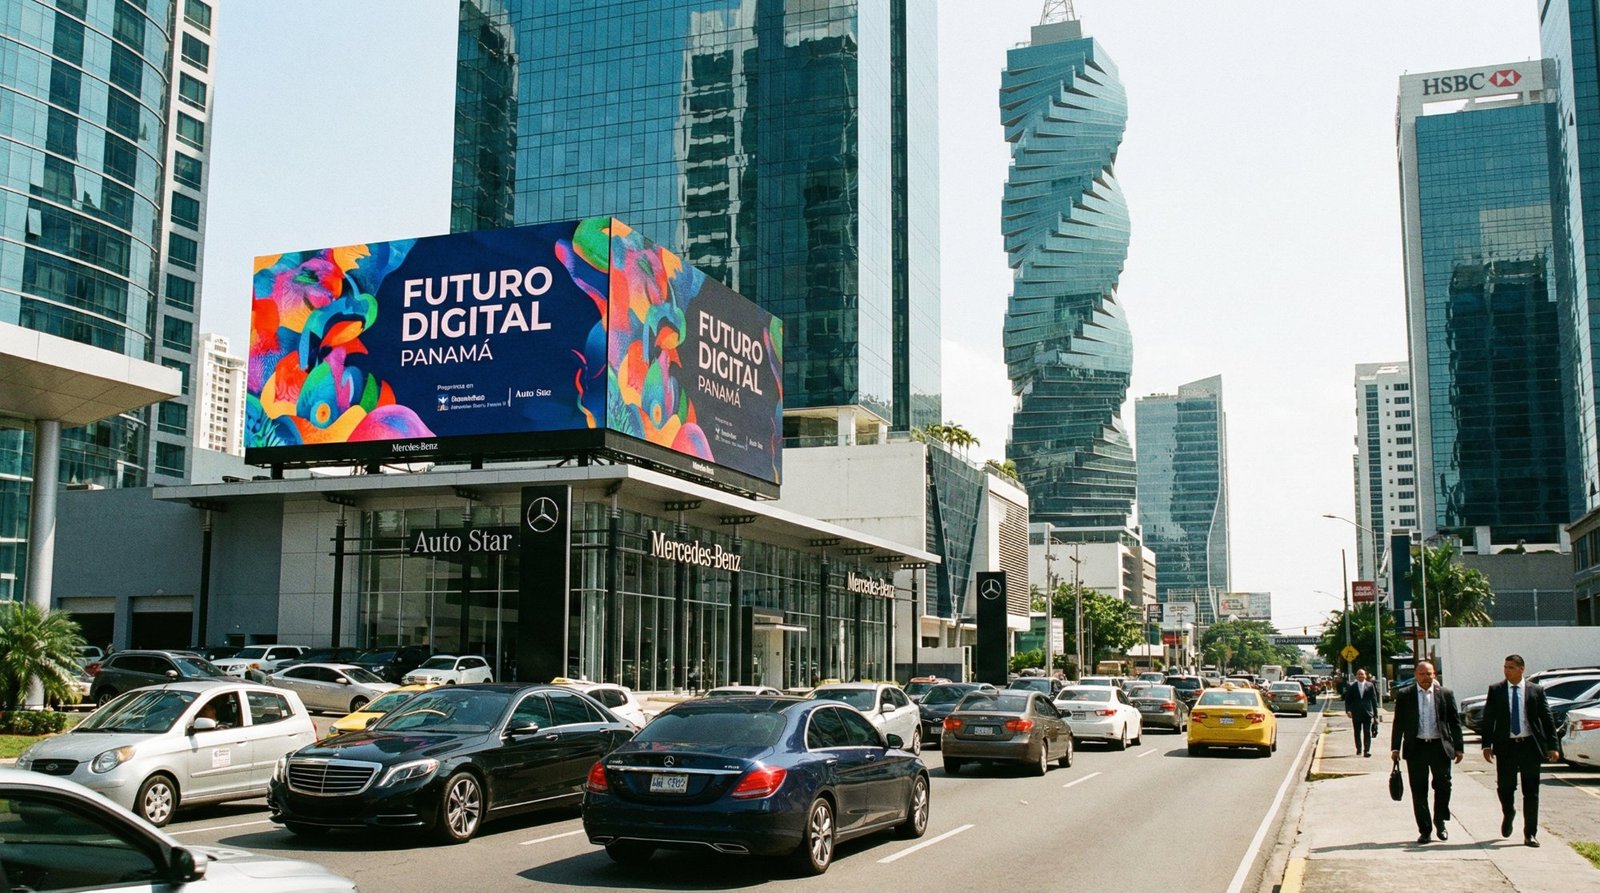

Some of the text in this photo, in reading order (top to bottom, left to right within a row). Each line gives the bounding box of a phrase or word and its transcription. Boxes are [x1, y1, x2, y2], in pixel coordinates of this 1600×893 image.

[1422, 73, 1485, 95] HSBC
[404, 266, 553, 307] FUTURO
[402, 301, 552, 342] DIGITAL
[699, 310, 763, 365] FUTURO
[401, 338, 493, 367] PANAMÁ
[699, 340, 763, 395] DIGITAL
[698, 374, 741, 408] PANAMÁ
[413, 529, 513, 553] Auto Star
[650, 530, 742, 572] Mercedes-Benz
